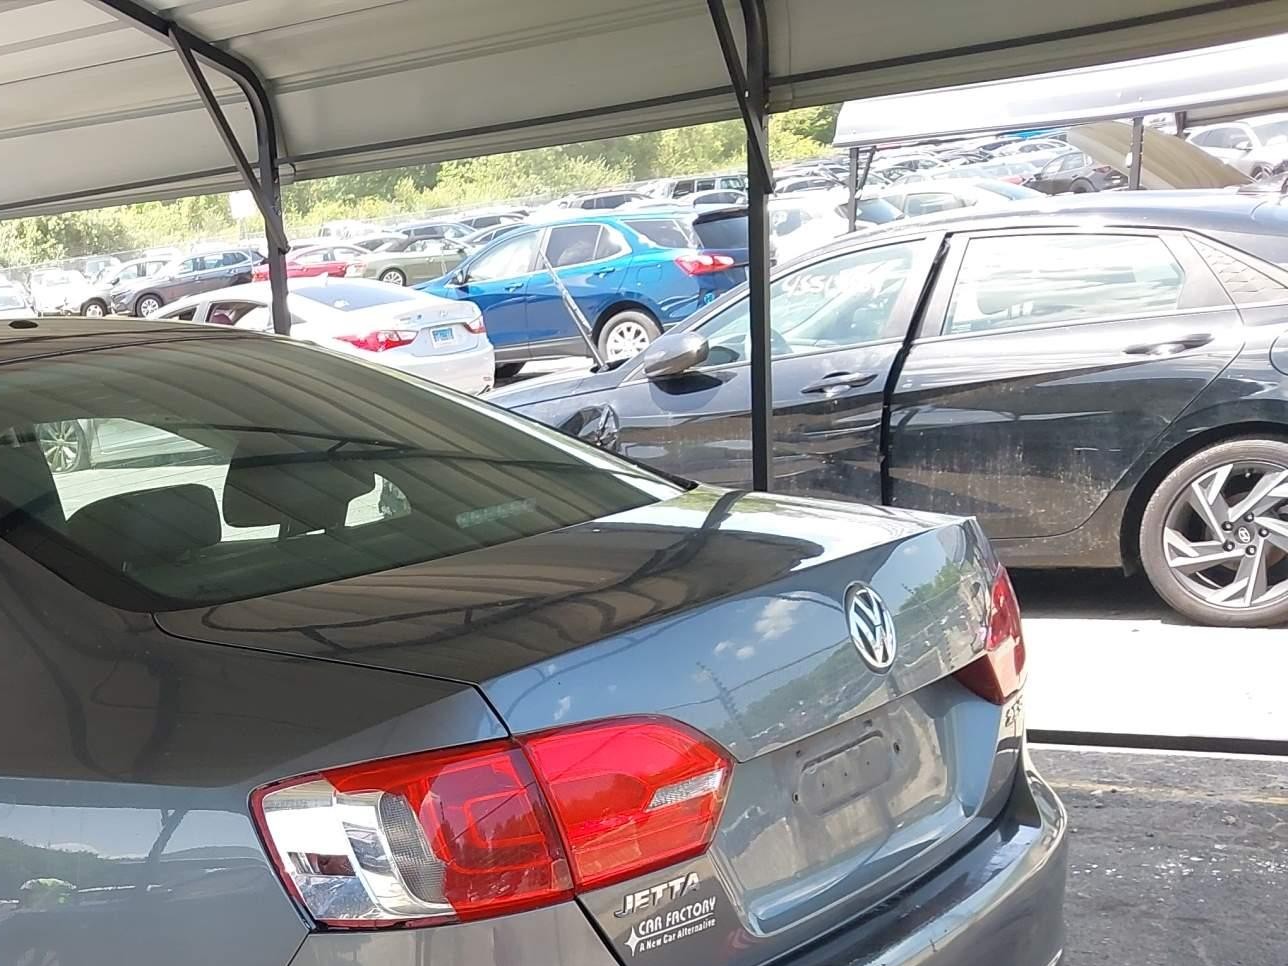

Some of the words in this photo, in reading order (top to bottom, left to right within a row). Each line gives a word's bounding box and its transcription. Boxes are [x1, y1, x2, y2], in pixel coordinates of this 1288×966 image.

[614, 872, 699, 918] JETTA
[638, 917, 662, 935] CAR
[665, 896, 716, 925] FACTORY
[639, 943, 645, 952] A
[646, 938, 661, 949] New
[663, 933, 676, 944] Car
[677, 918, 716, 938] Alternative
